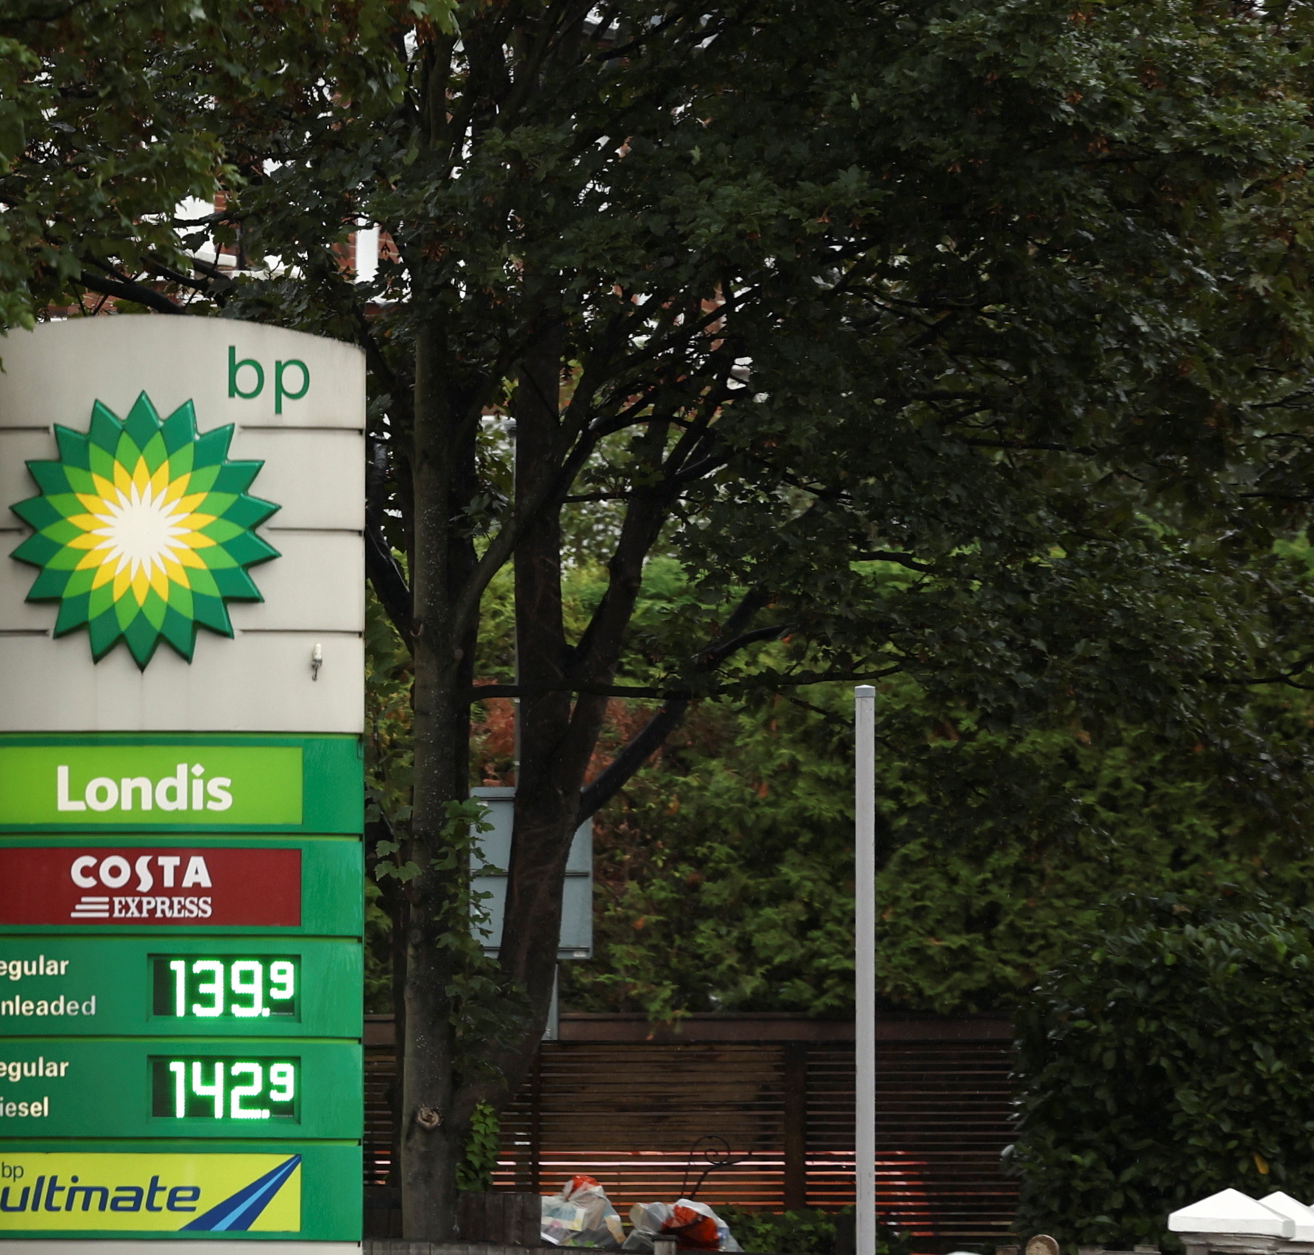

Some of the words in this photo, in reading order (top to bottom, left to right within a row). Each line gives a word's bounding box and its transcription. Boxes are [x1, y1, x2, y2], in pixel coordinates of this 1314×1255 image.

[228, 345, 311, 414] bp
[57, 762, 233, 812] Londis
[70, 855, 212, 892] COSTA
[112, 896, 212, 919] EXPRESS
[1, 1162, 24, 1182] bp
[0, 1175, 201, 1212] ultimate
